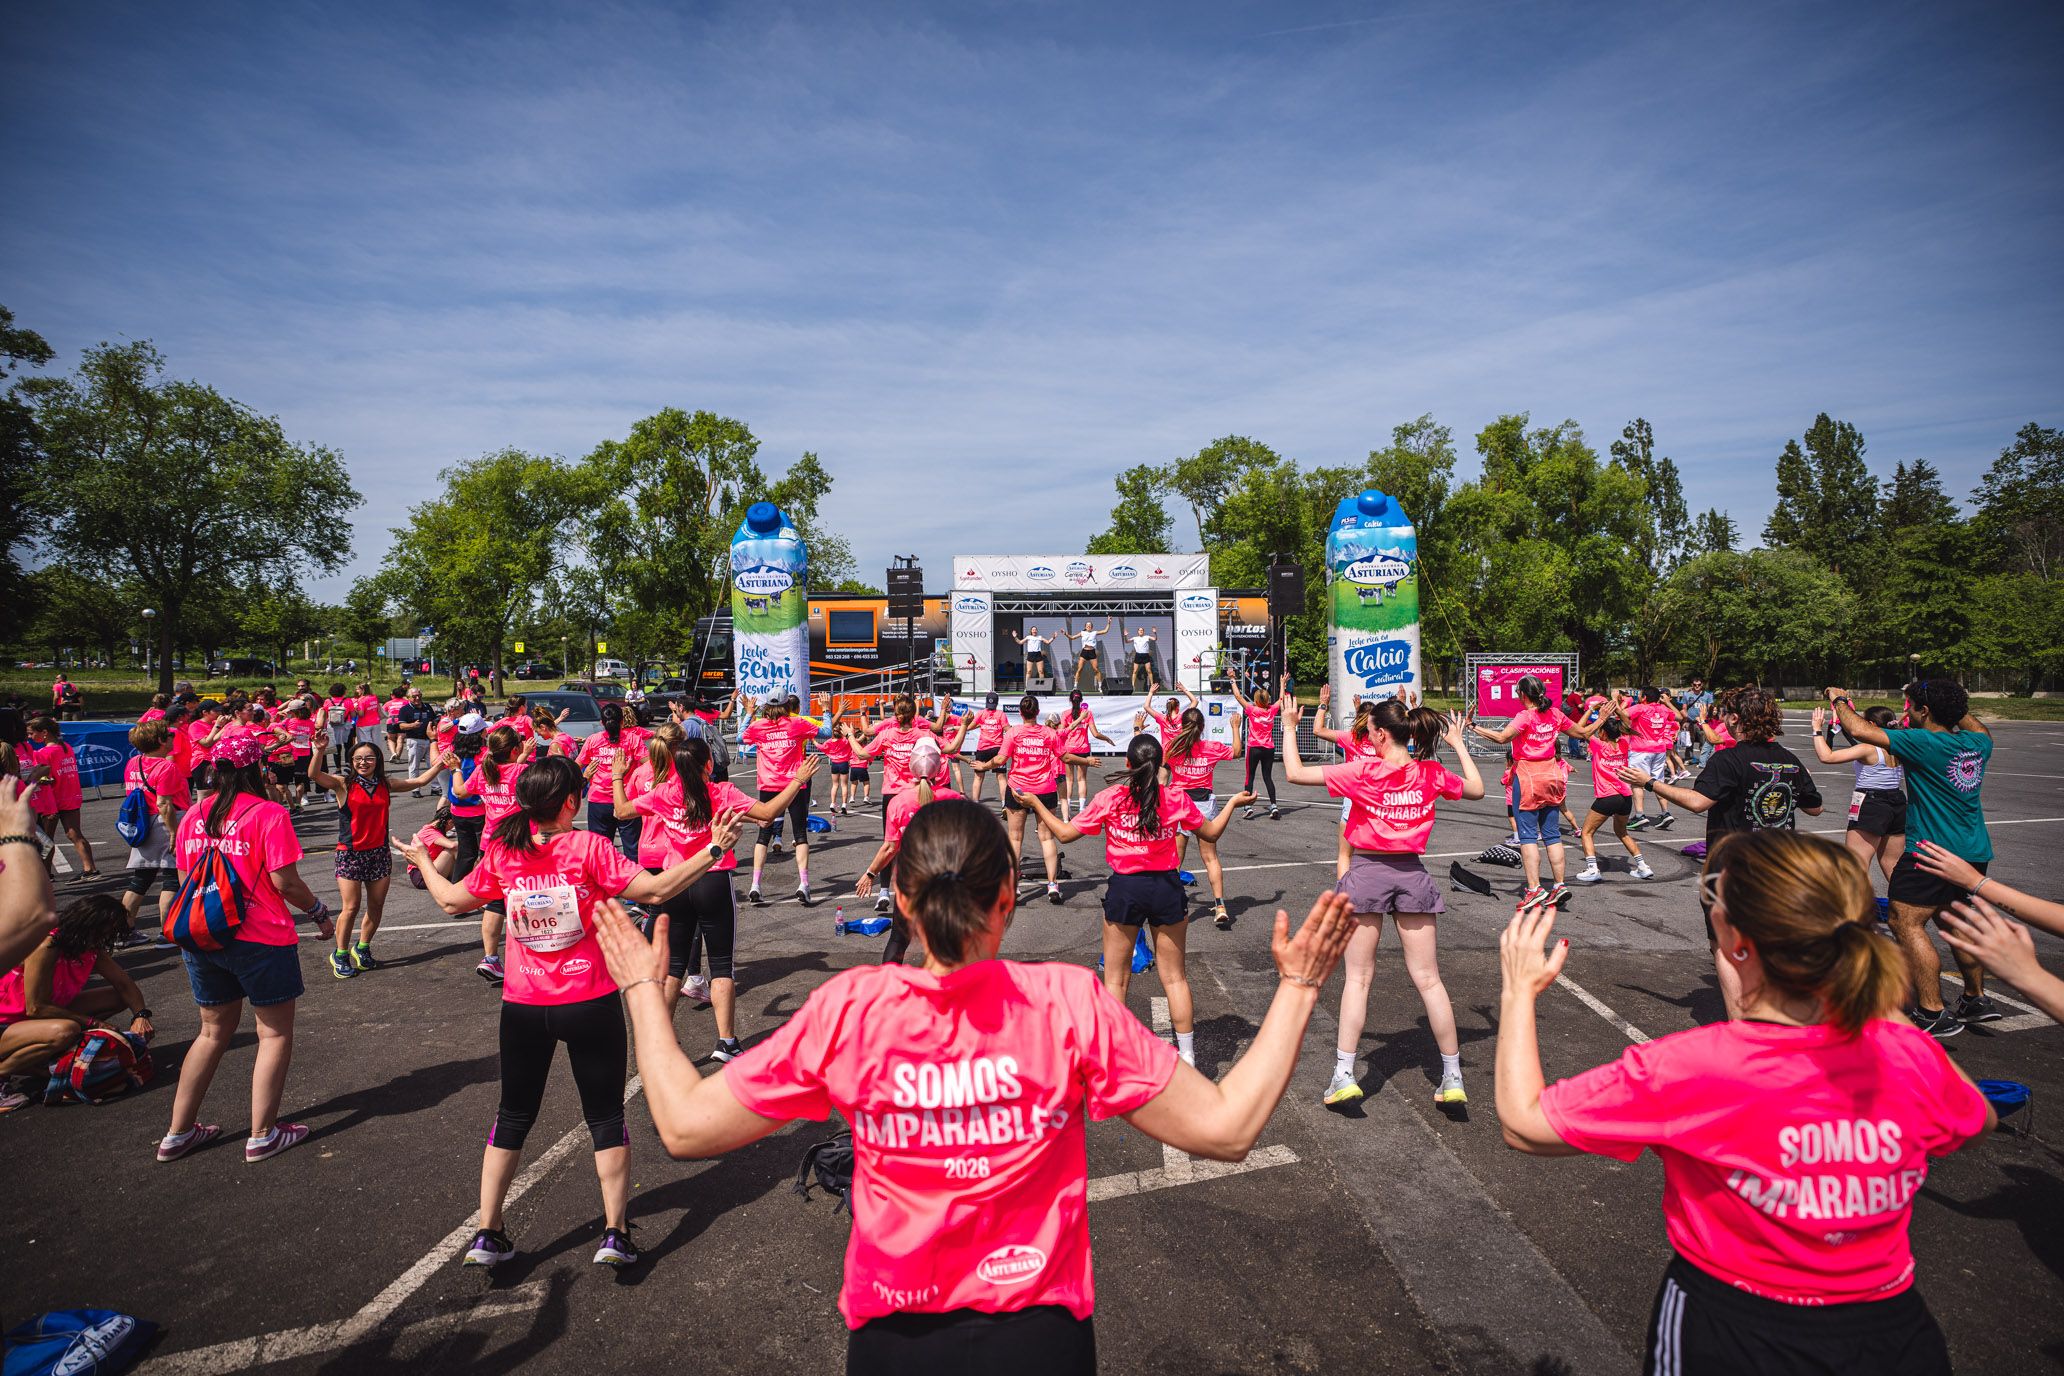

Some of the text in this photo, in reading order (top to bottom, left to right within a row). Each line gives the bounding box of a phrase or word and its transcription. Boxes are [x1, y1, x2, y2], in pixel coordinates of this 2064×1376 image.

[1348, 566, 1406, 578] ASTURIANA
[738, 576, 789, 588] ASTURIANA
[1181, 629, 1213, 637] OYSHO
[1350, 647, 1404, 673] Calcio
[739, 656, 796, 681] semi
[1374, 671, 1404, 684] natural
[740, 679, 798, 695] desnatda
[765, 731, 788, 740] SOMOS
[1022, 737, 1044, 746] SOMOS
[598, 747, 616, 756] SOM
[1382, 790, 1424, 806] SOMOS
[531, 917, 557, 929] 016
[562, 963, 590, 974] ASTURIANA
[893, 1055, 1023, 1109] SOMOS
[1778, 1118, 1903, 1168] SOMOS
[944, 1156, 991, 1180] 2026
[983, 1258, 1041, 1280] ASTURIANA
[64, 1320, 131, 1372] ASURIANA
